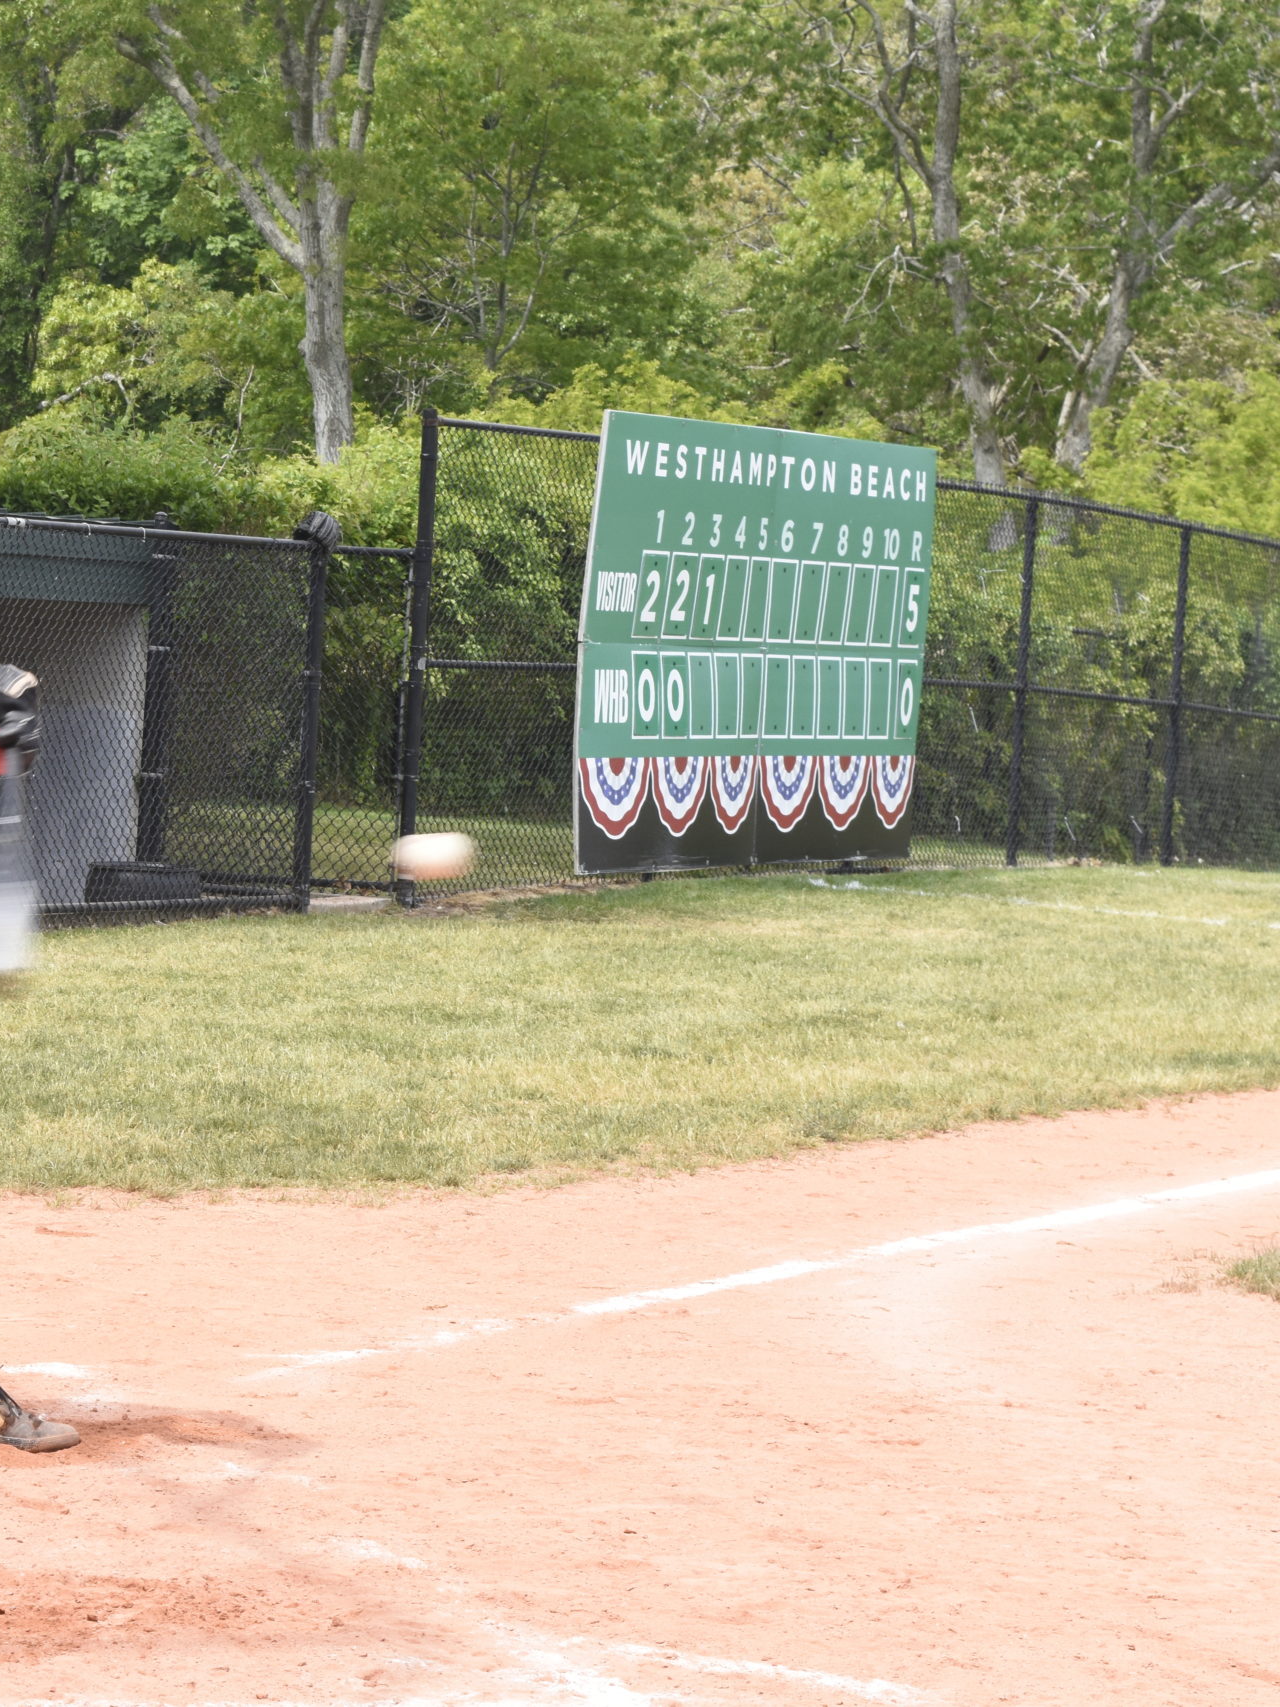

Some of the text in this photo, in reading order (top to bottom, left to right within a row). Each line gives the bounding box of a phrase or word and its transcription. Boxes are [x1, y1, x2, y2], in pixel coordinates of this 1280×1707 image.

[626, 439, 926, 502] WESTHAMPTON BEACH
[657, 509, 922, 562] 1 2 3 4 5 6 7 8 9 10 R
[596, 569, 920, 632] VISITOR 2 2 1 5
[594, 668, 913, 726] WHB 0 0 0
